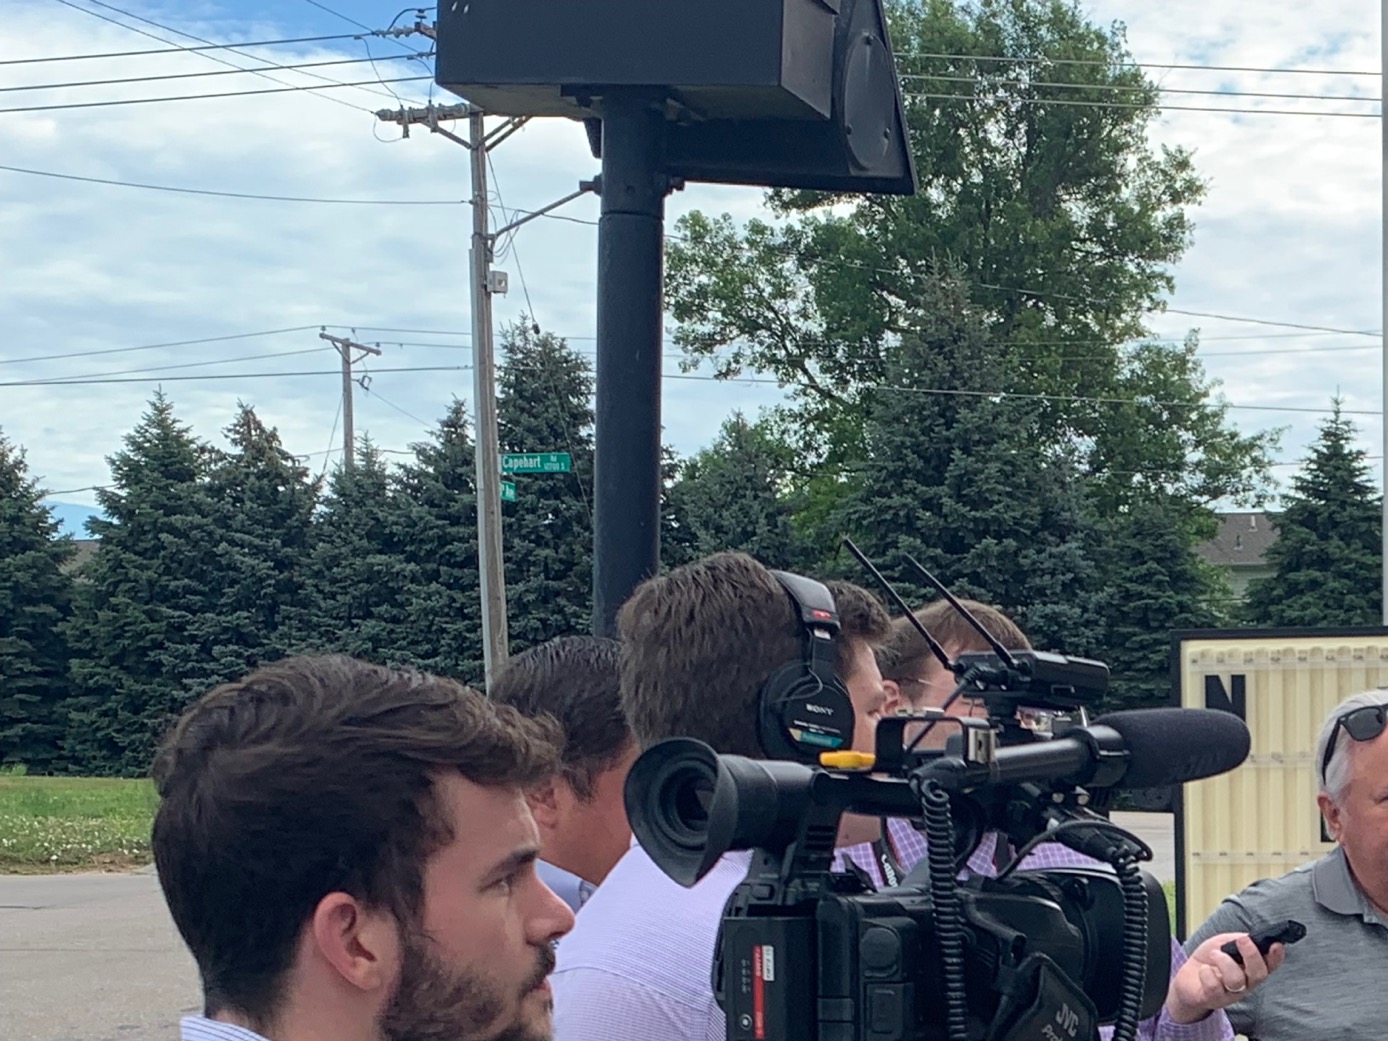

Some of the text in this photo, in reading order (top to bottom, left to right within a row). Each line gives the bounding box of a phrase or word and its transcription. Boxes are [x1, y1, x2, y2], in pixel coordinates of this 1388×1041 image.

[502, 455, 541, 471] Capehart
[805, 703, 834, 716] SONY
[1205, 674, 1246, 722] N
[1055, 1002, 1079, 1038] JVC
